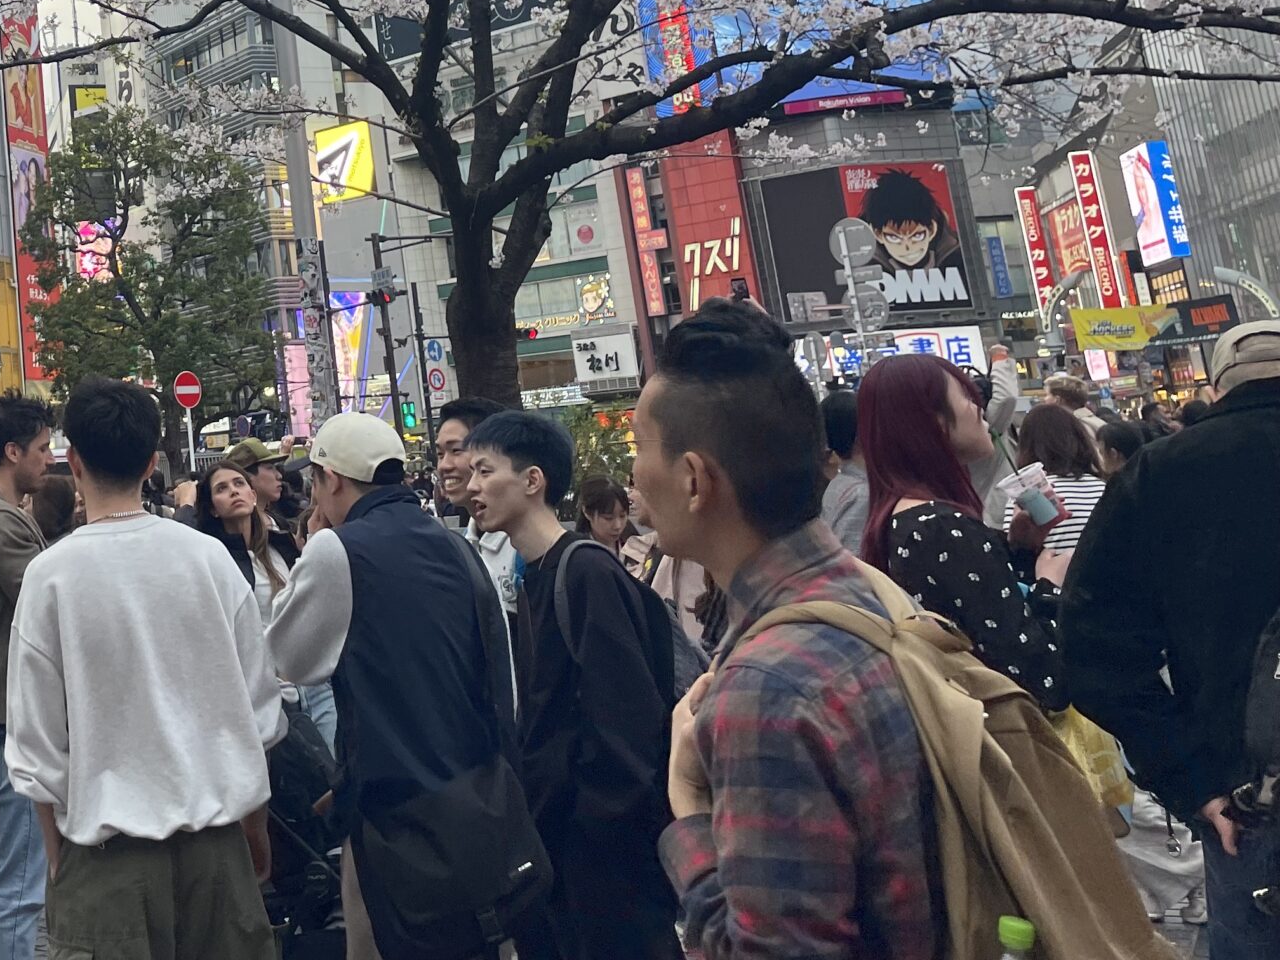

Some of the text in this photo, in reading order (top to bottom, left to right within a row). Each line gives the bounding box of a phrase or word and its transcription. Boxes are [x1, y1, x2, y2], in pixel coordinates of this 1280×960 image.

[818, 96, 871, 109] Rakuten Vision
[1075, 162, 1104, 240] カラオケ
[870, 266, 969, 304] DMM
[1100, 266, 1113, 297] ECHO
[587, 352, 620, 373] 松川
